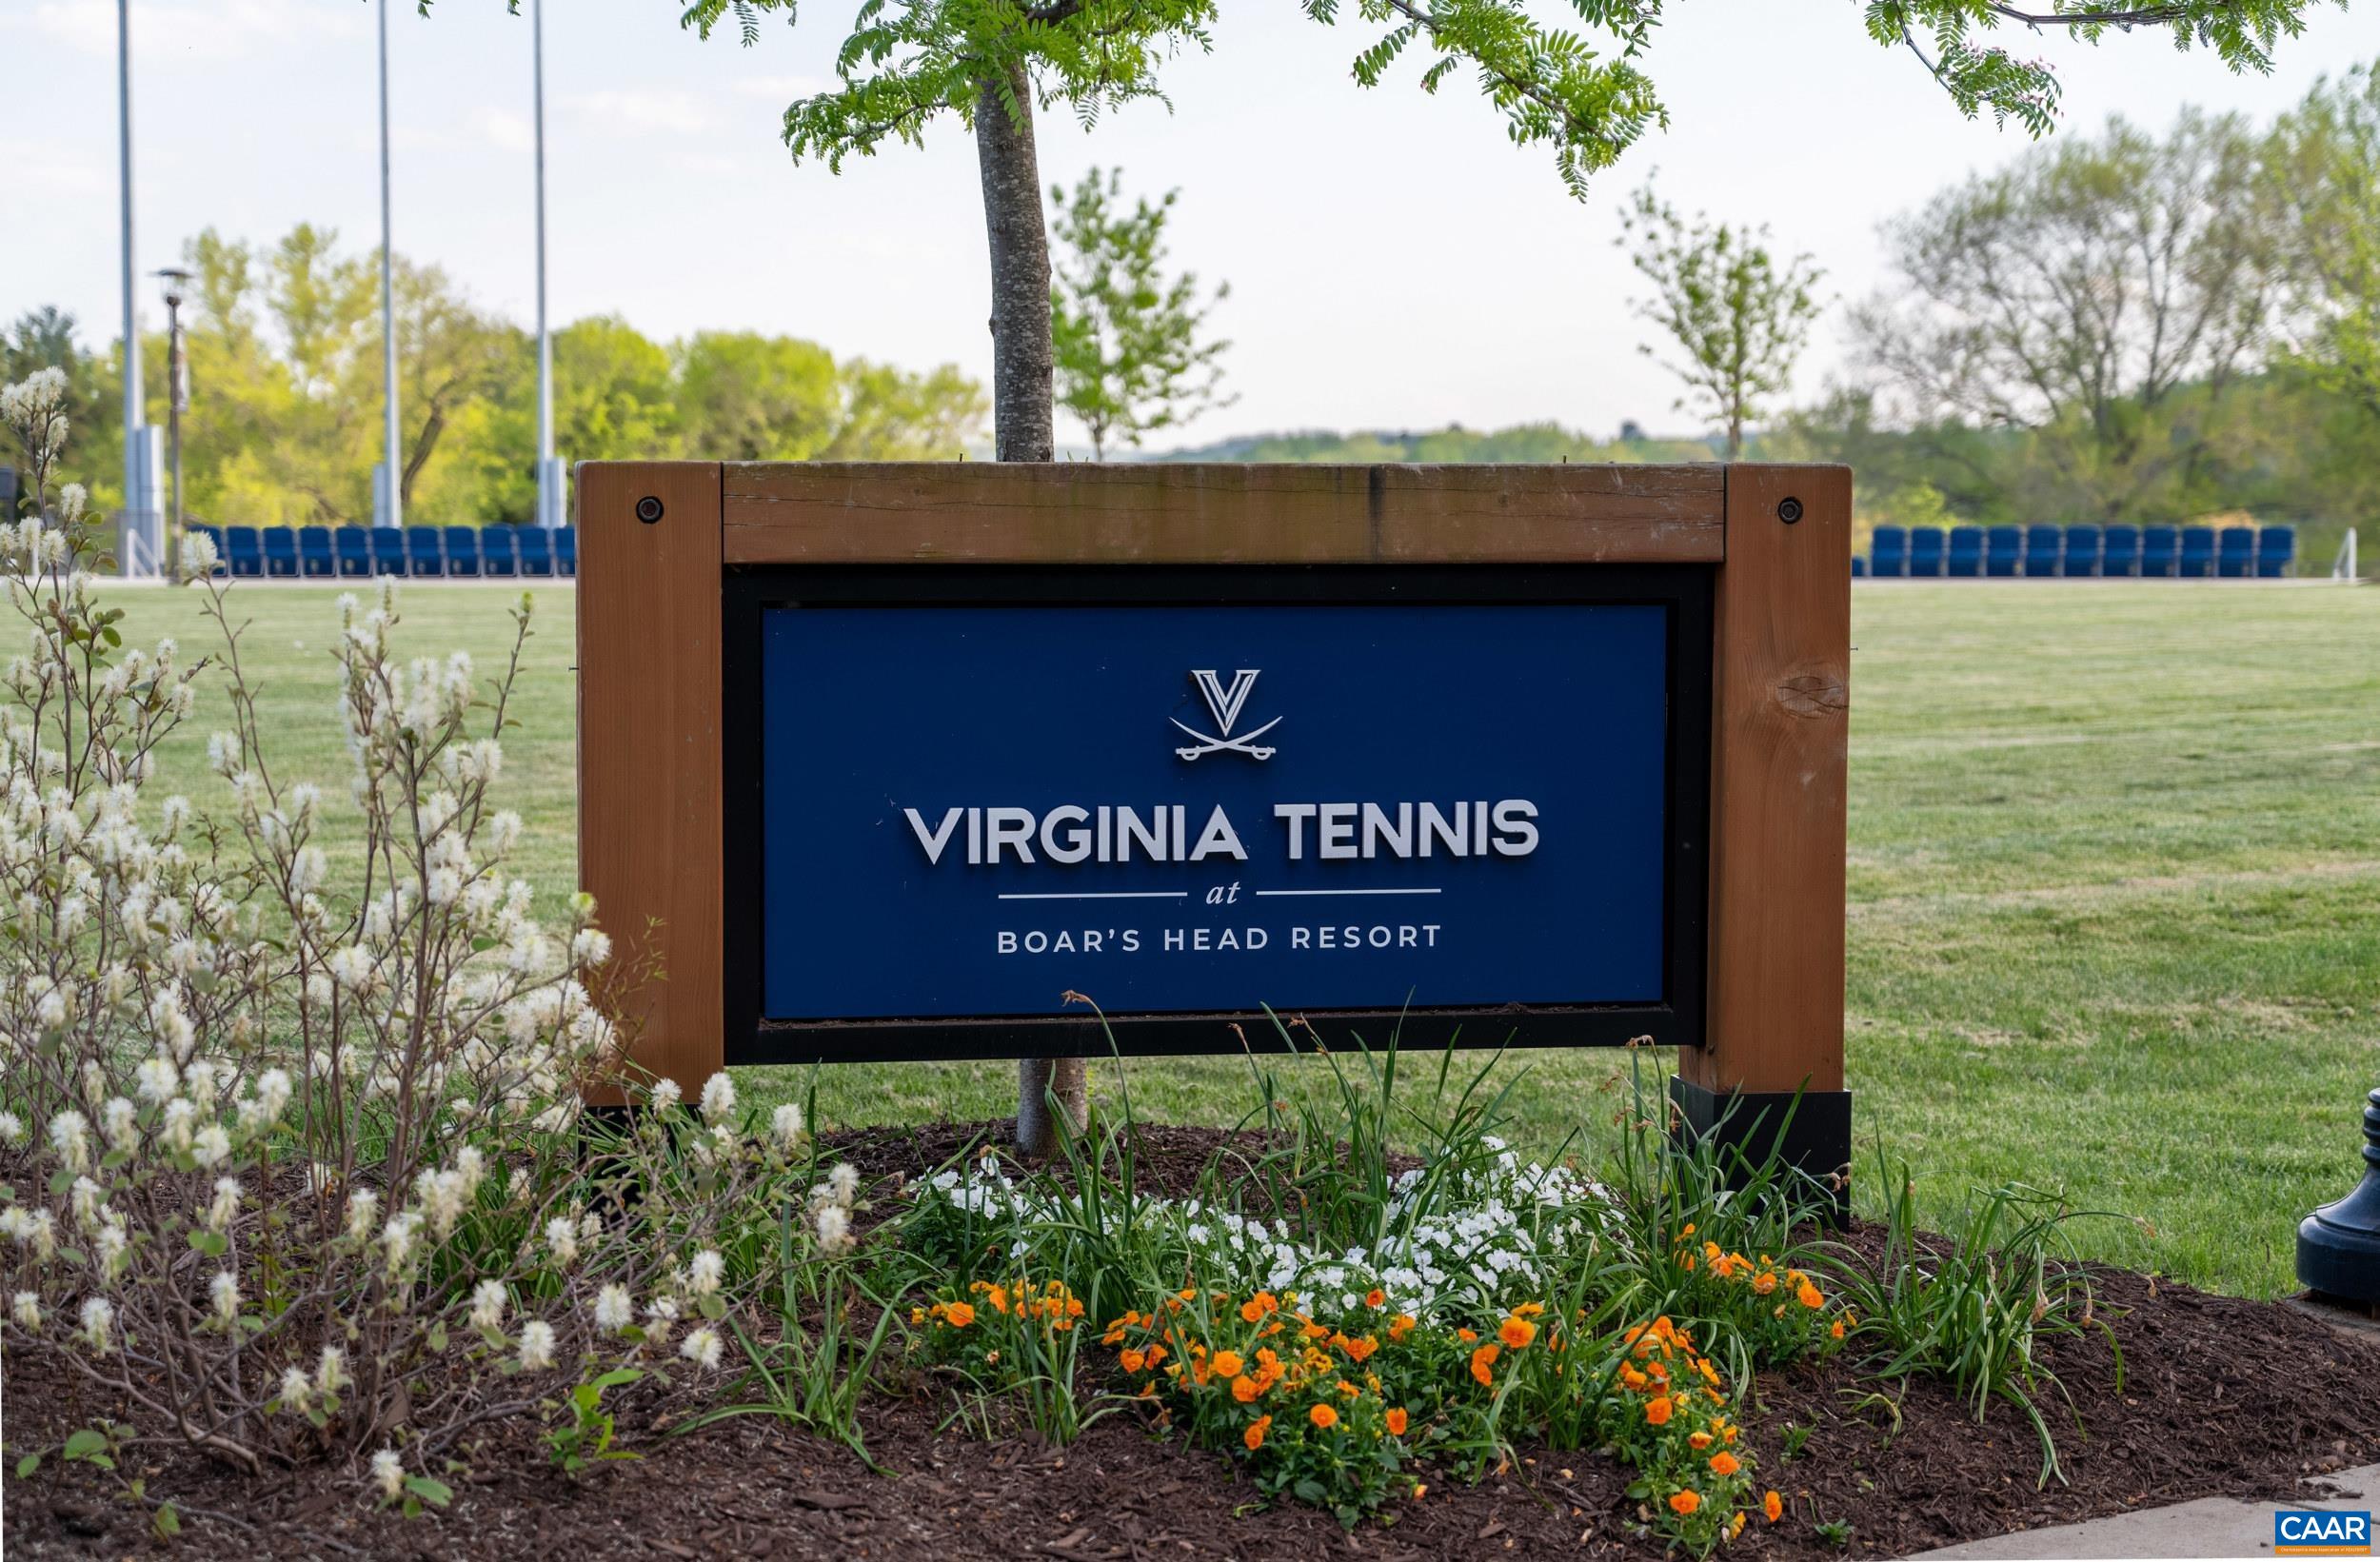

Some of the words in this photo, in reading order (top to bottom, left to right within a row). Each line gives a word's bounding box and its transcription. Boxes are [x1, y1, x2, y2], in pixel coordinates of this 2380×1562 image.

[903, 804, 1249, 865] VIRGINIA
[1274, 800, 1539, 860] TENNIS
[1205, 881, 1240, 904] at
[997, 929, 1140, 954] BOAR'S
[1163, 928, 1269, 951] HEAD
[1291, 925, 1441, 949] RESORT
